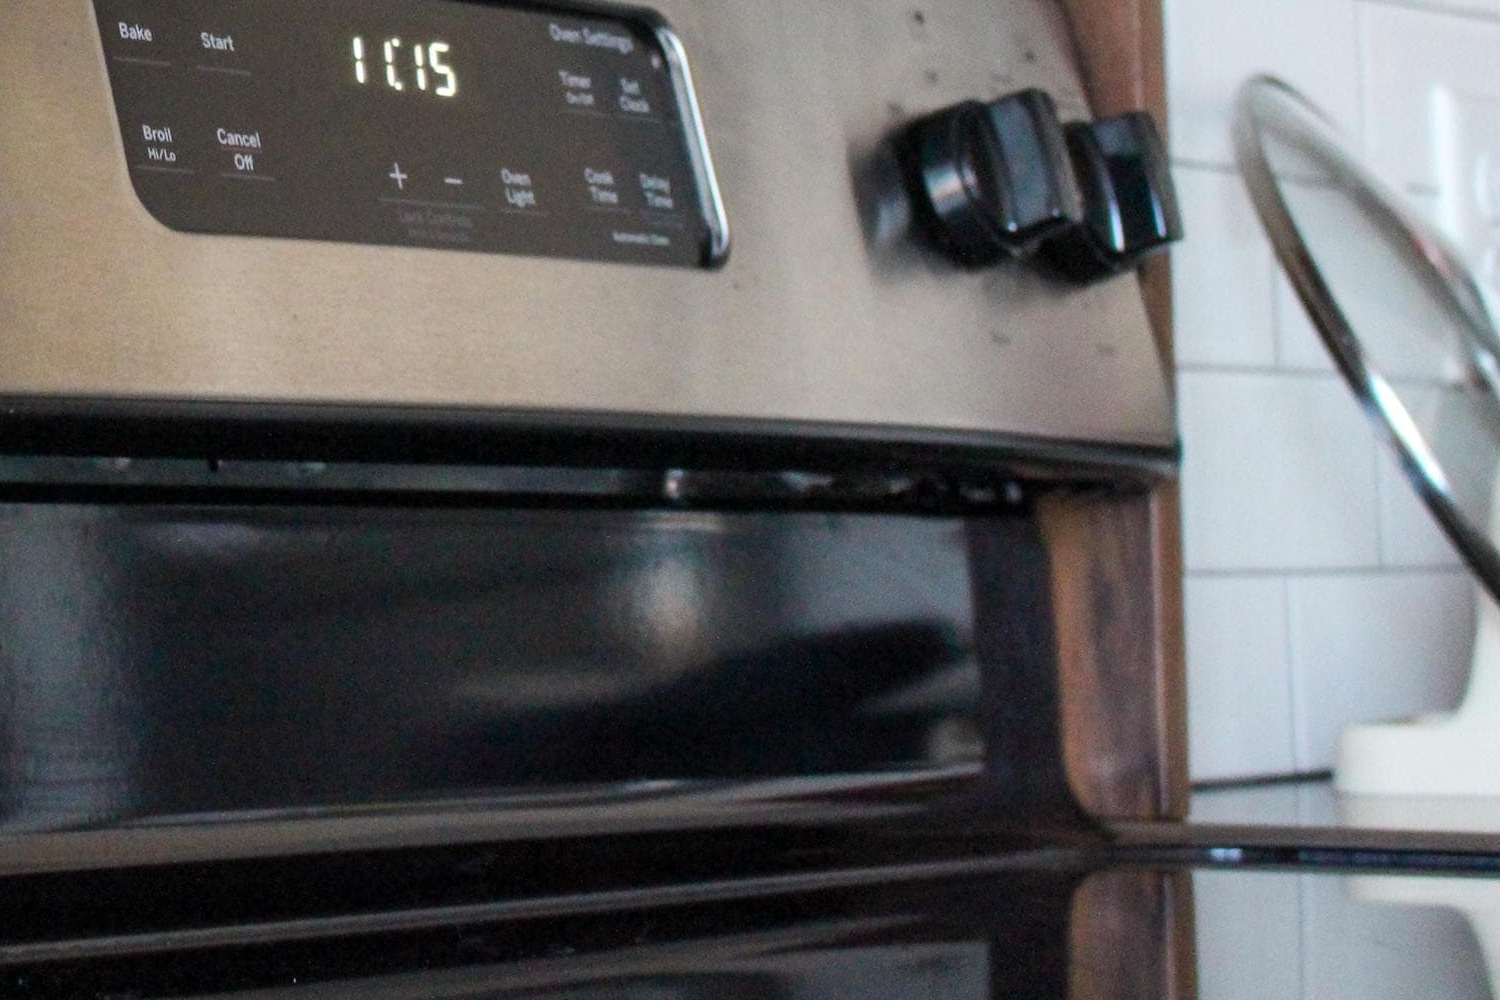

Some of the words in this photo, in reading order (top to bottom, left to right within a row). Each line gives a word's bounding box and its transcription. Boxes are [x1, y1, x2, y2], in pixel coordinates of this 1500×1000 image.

[118, 22, 153, 42] Bake
[201, 32, 235, 52] Start
[548, 23, 580, 42] Oven
[142, 124, 173, 143] Broil
[217, 127, 262, 149] Cancel
[148, 146, 176, 162] Hi/Lo
[234, 153, 255, 171] Off
[501, 167, 532, 187] Oven
[505, 187, 536, 208] Light
